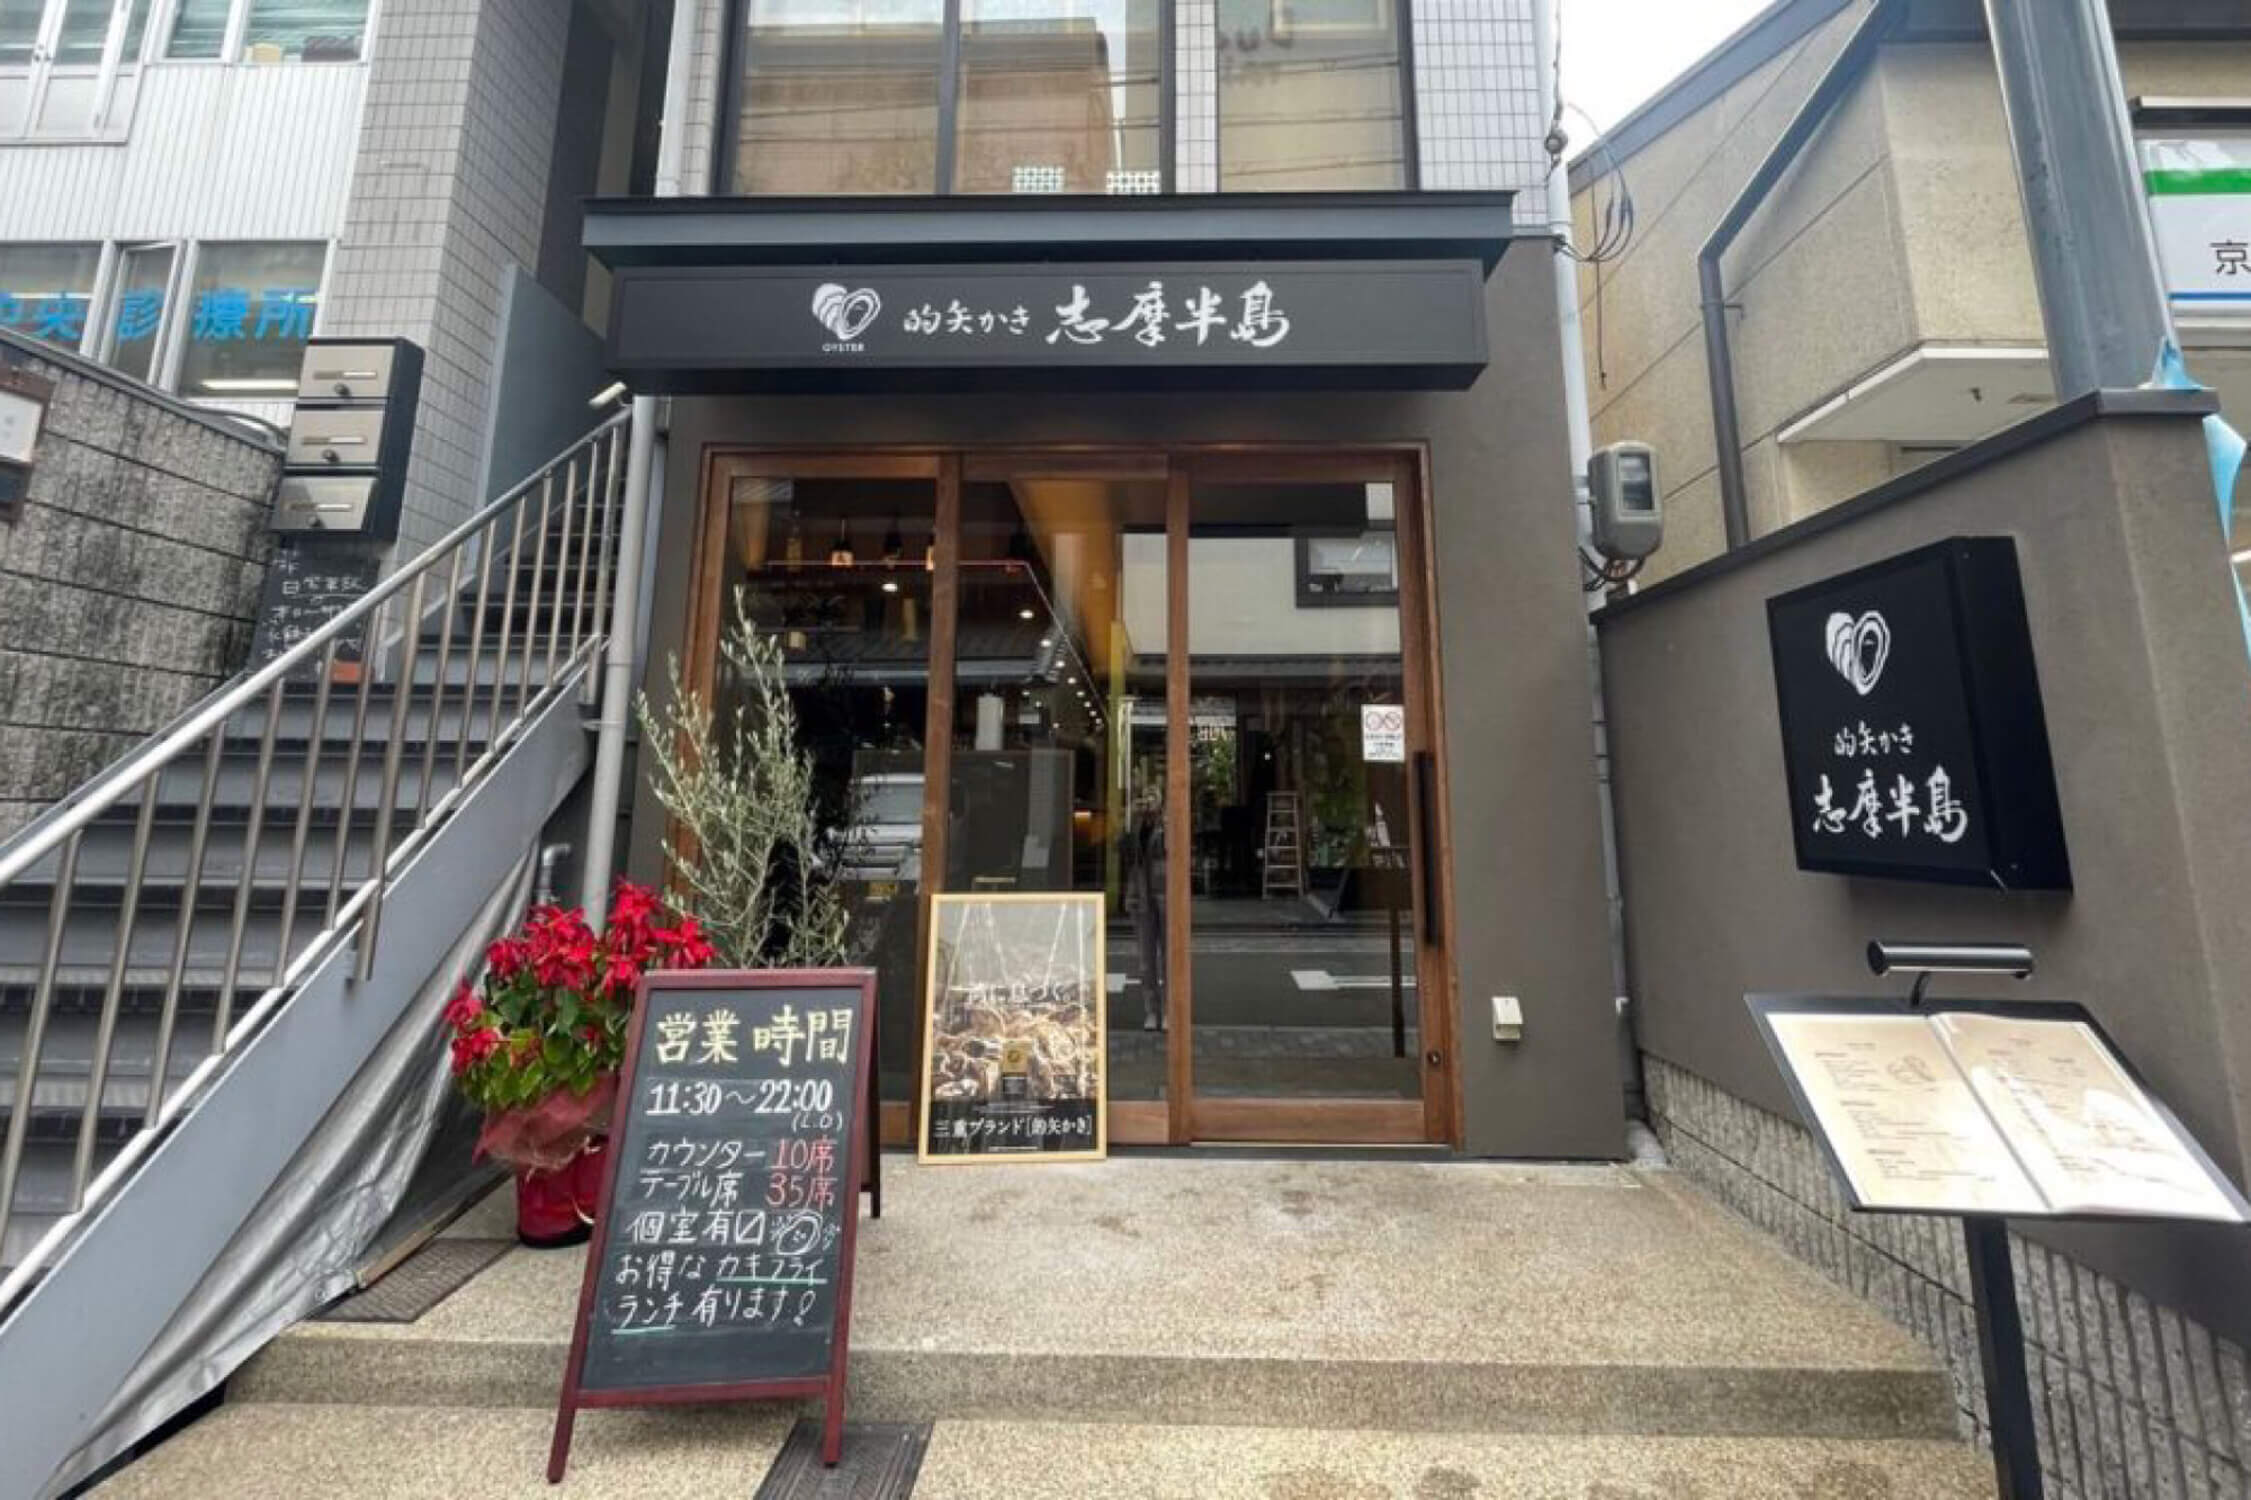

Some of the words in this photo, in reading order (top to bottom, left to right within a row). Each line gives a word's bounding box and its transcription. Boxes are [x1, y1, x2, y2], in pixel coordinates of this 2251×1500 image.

[2209, 238, 2251, 275] 京
[904, 299, 1030, 335] 的矢かき
[1045, 281, 1290, 346] 志摩半島
[1834, 720, 1914, 757] 的矢かき
[1812, 764, 1968, 842] 志摩半島
[656, 1004, 854, 1068] 営業時間
[648, 1137, 766, 1169] カウンター
[763, 1134, 838, 1173] 10席
[640, 1170, 744, 1208] テーブル席
[765, 1172, 838, 1212] 35席
